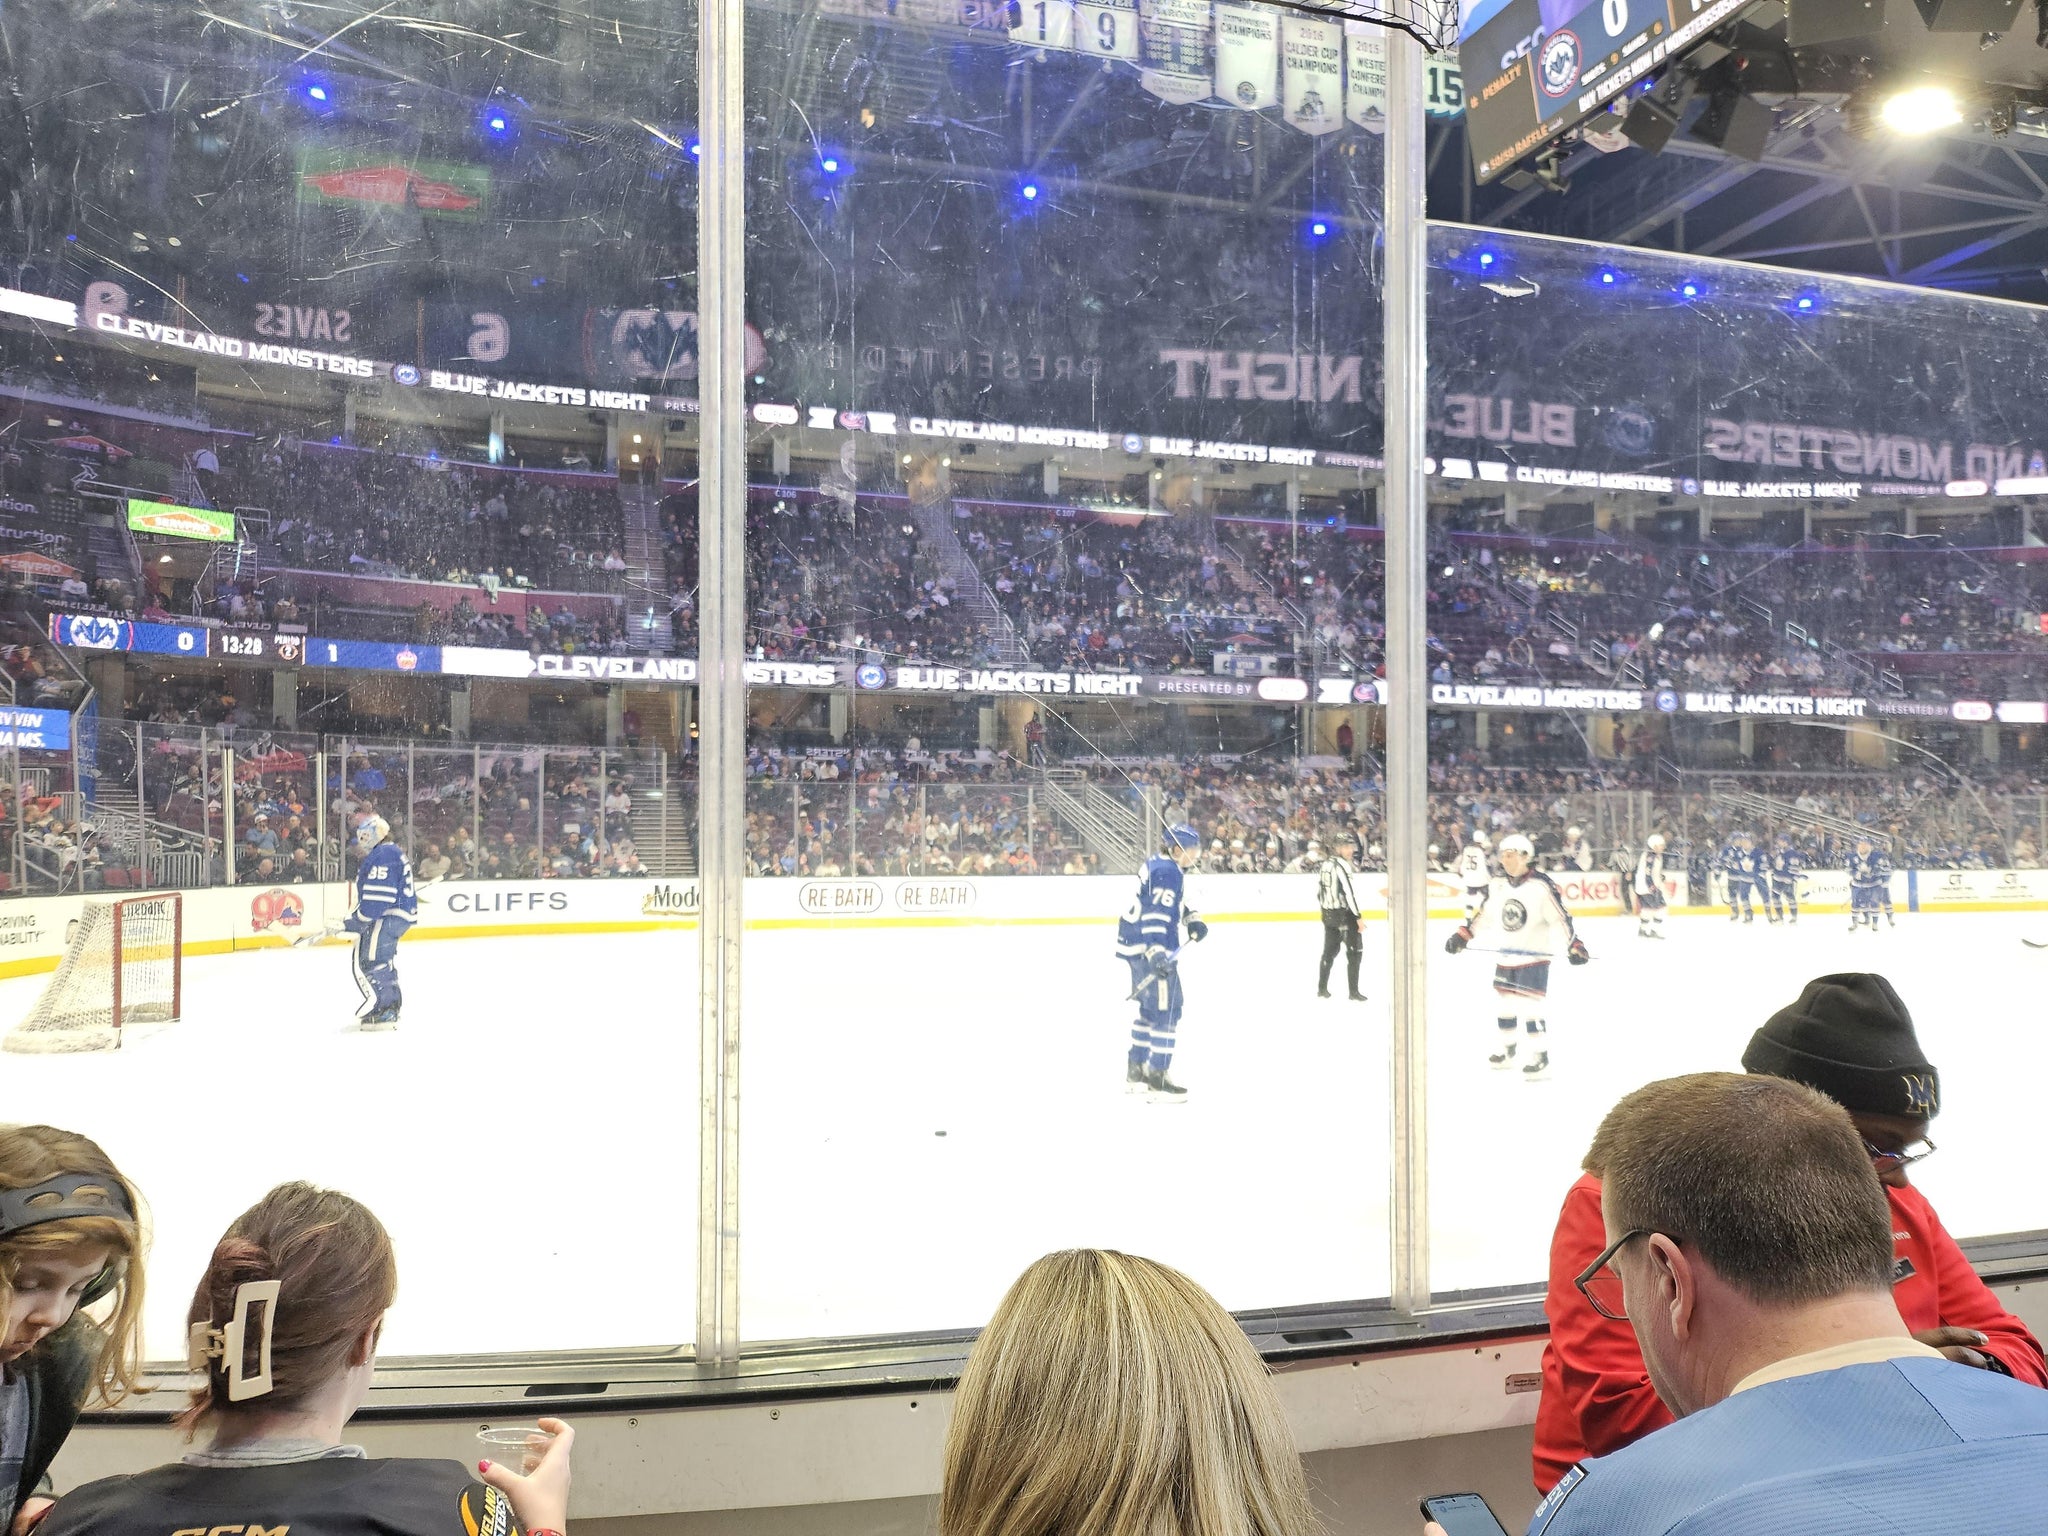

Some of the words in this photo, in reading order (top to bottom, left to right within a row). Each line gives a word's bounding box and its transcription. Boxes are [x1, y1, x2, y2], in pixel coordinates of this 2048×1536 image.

[1356, 57, 1386, 71] WESTE
[1351, 70, 1386, 86] CONFERE
[1429, 67, 1462, 107] 15
[97, 312, 243, 358] CLEVELAND
[248, 341, 374, 378] MONSTERS
[430, 371, 487, 396] BLUE
[489, 379, 587, 407] JACKETS
[589, 389, 651, 412] NIGHT
[665, 402, 700, 414] PRESE
[909, 416, 1015, 442] CLEVELAND
[1017, 426, 1110, 450] MONSTERS
[1150, 437, 1193, 456] BLUE
[1516, 465, 1598, 488] CLEVELAND
[1703, 480, 1740, 497] BLUE
[1741, 482, 1811, 498] JACKETS
[177, 631, 194, 651] 0
[327, 643, 338, 663] 1
[537, 655, 697, 682] CLEVELAND
[743, 662, 837, 686] STERS
[897, 668, 959, 691] BLUE
[963, 670, 1071, 694] JACKETS
[1075, 673, 1143, 696] NIGHT
[1157, 681, 1232, 695] PRESENTED
[1236, 682, 1252, 695] BY
[1432, 685, 1542, 707] CLEVELAND
[1544, 688, 1643, 710] MONSTERS
[1685, 693, 1732, 712] BLUE
[1734, 694, 1813, 716] JACKETS
[1815, 698, 1867, 717] NIGHT
[403, 862, 415, 898] 3
[447, 891, 569, 913] CLIFFS
[930, 886, 967, 905] BATH
[1151, 887, 1176, 908] 76
